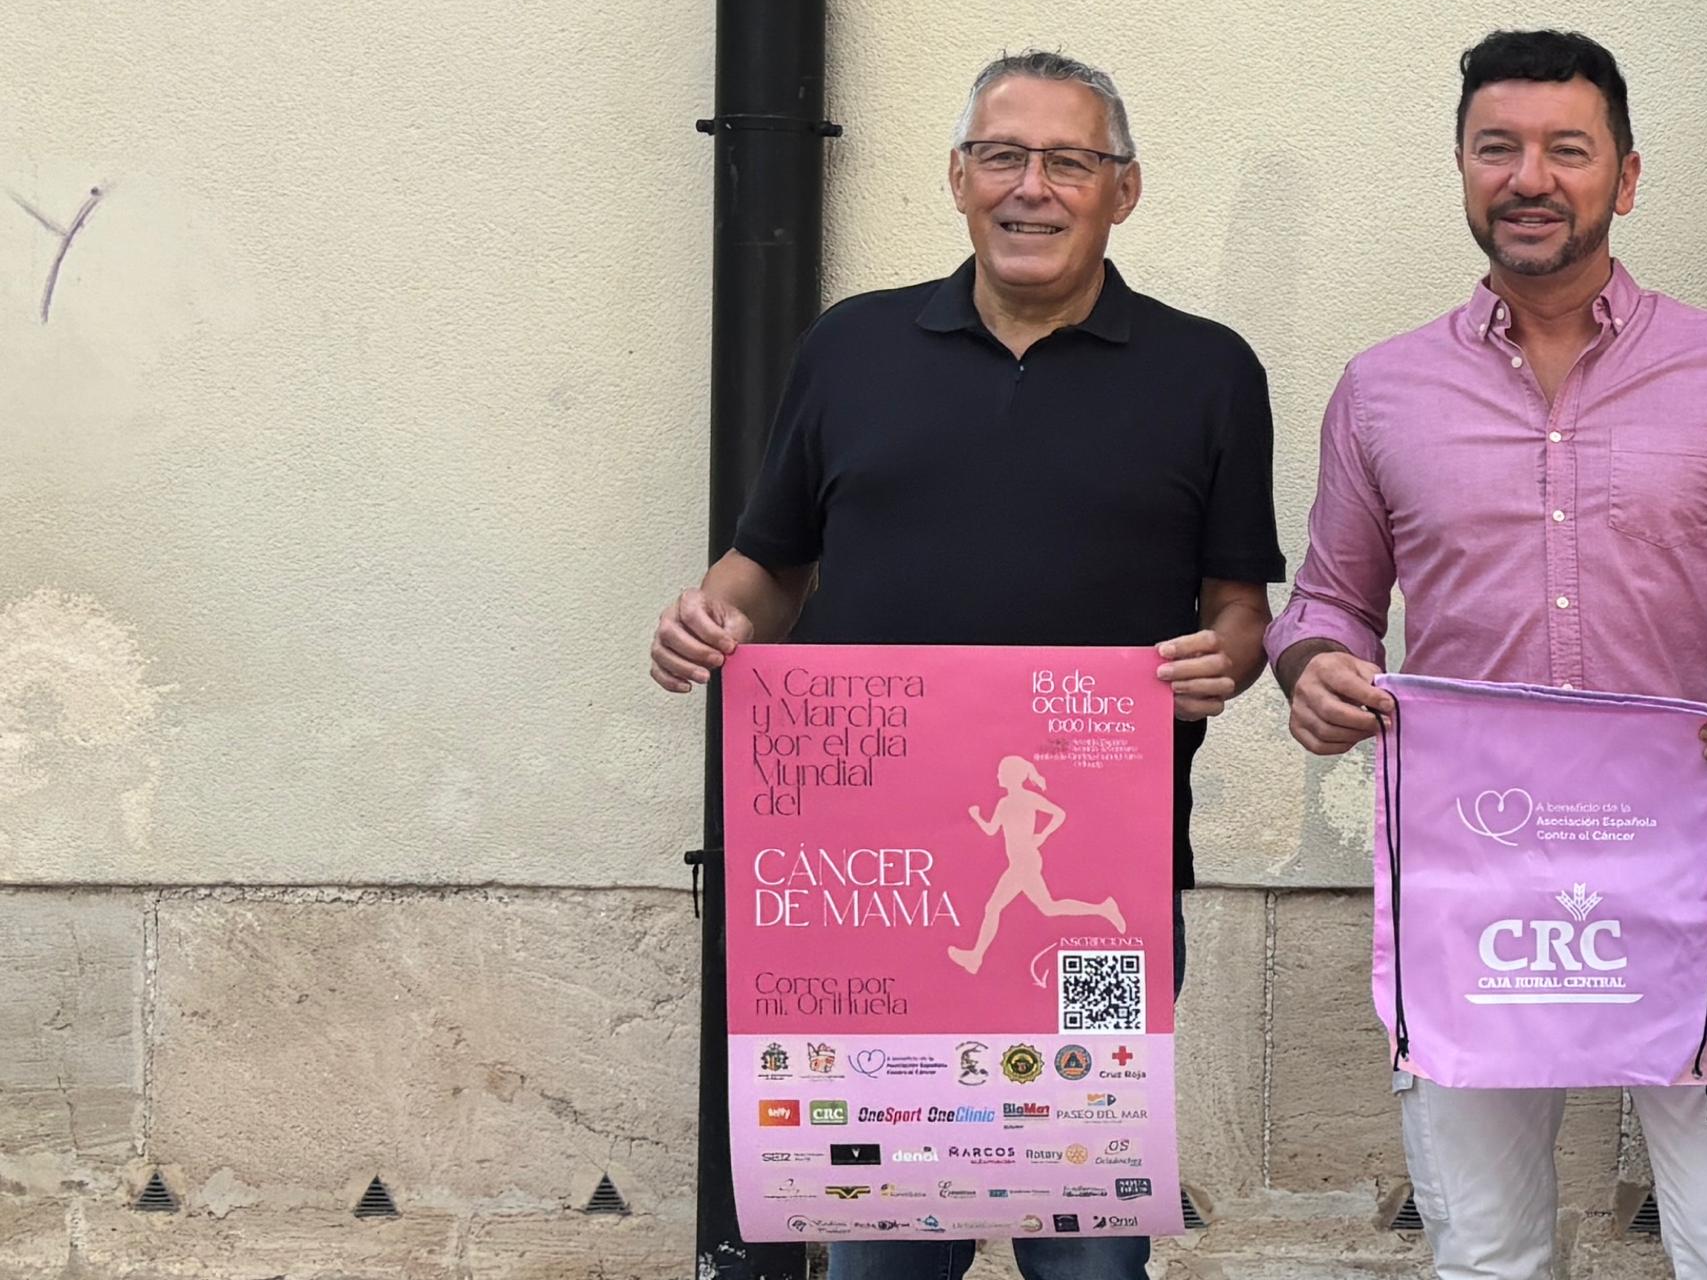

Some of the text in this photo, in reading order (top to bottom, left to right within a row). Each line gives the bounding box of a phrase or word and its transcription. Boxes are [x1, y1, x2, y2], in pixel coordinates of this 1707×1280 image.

[784, 667, 925, 698] Carrera
[1032, 669, 1096, 694] 18 de
[753, 698, 907, 734] y Marcha
[1032, 691, 1134, 715] octubre
[1088, 718, 1136, 733] horas
[753, 732, 812, 763] por
[823, 727, 849, 757] el
[753, 756, 873, 786] Mundial
[753, 785, 801, 816] del
[1602, 802, 1618, 813] de
[1536, 816, 1657, 828] Asociación Española
[1536, 830, 1635, 840] Contra el Cáncer
[754, 843, 934, 888] CÁNCER
[755, 889, 960, 927] DE MAMA
[1478, 919, 1628, 971] CRC
[755, 972, 895, 1002] Corre por
[1477, 976, 1626, 988] CAJA RURAL CENTRAL
[858, 1106, 995, 1125] OneSport OneClinic
